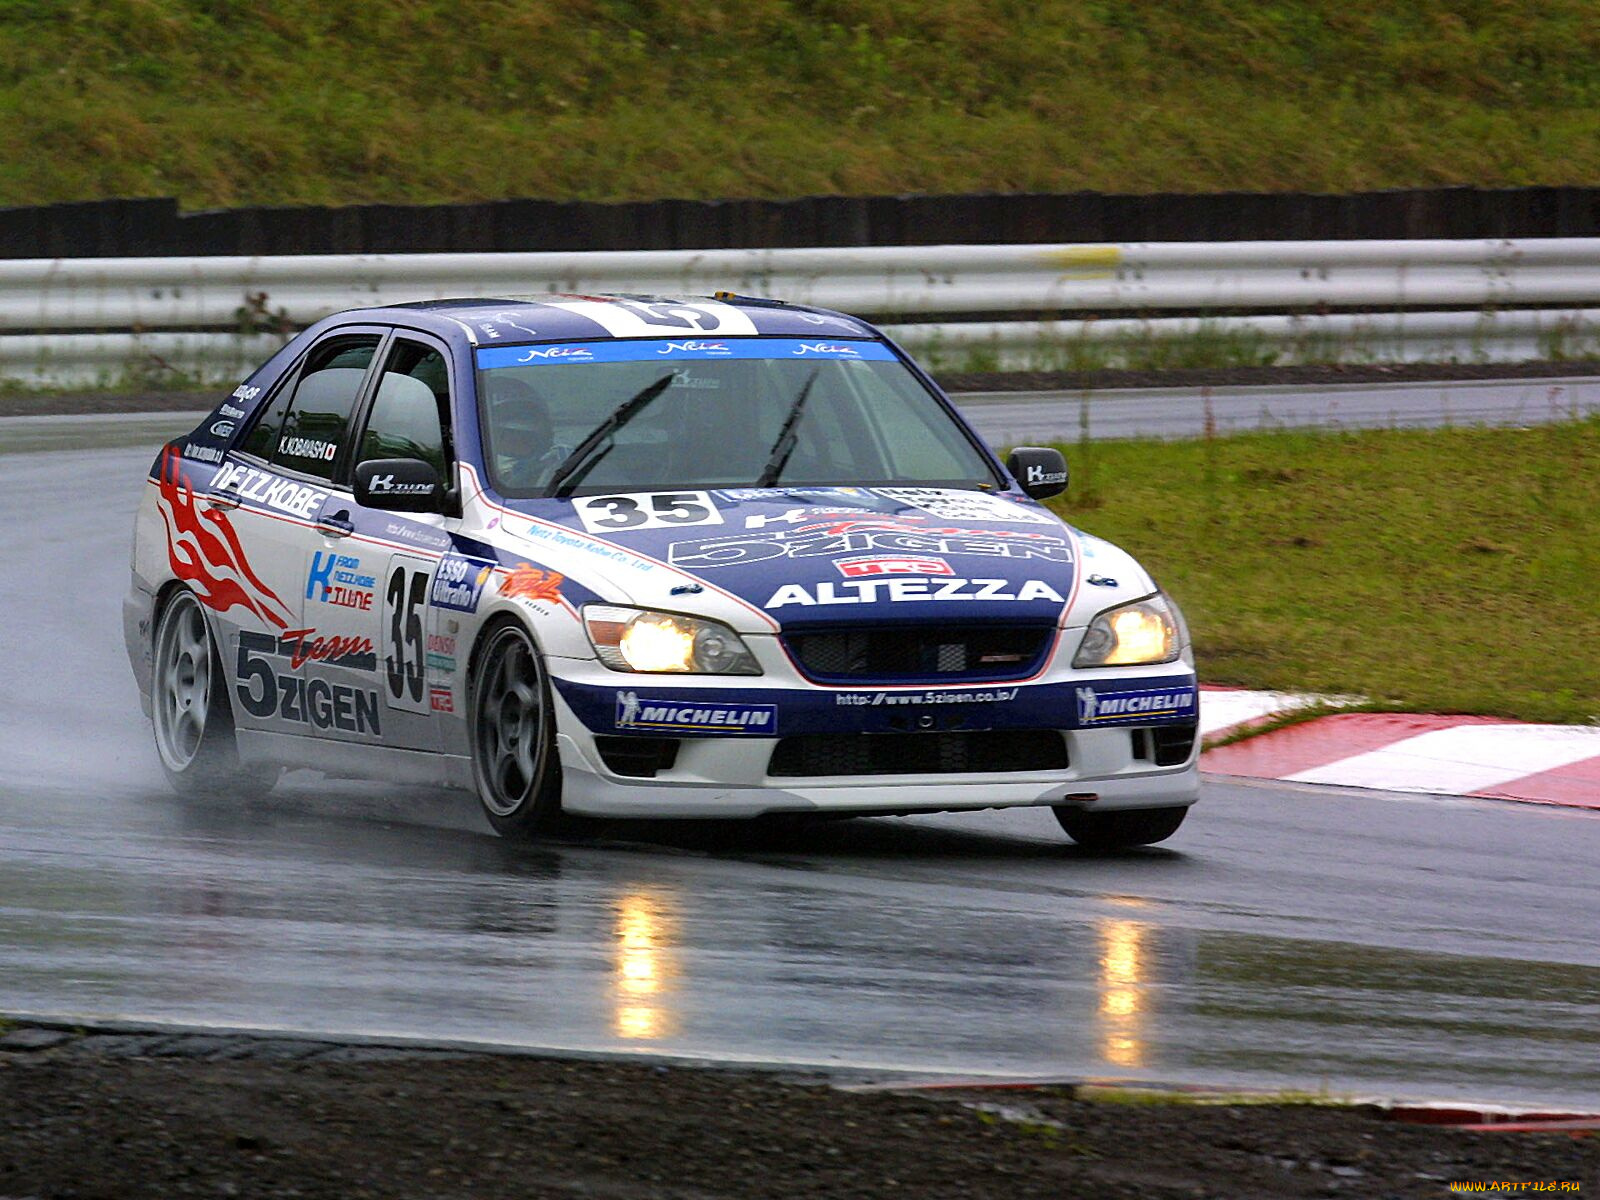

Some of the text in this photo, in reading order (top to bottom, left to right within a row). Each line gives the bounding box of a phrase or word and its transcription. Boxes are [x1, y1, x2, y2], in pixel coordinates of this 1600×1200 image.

[587, 494, 711, 528] 35
[527, 525, 552, 539] Netz
[552, 531, 585, 548] Toyota
[585, 543, 611, 557] Kobe
[438, 559, 468, 583] ESSO
[843, 562, 946, 575] TRD
[764, 578, 1065, 609] ALTEZZA
[281, 628, 373, 670] Team
[387, 566, 430, 703] 35
[236, 630, 381, 736] 5ZIGEN
[641, 706, 771, 726] MICHELIN
[1100, 692, 1193, 714] MICHELIN
